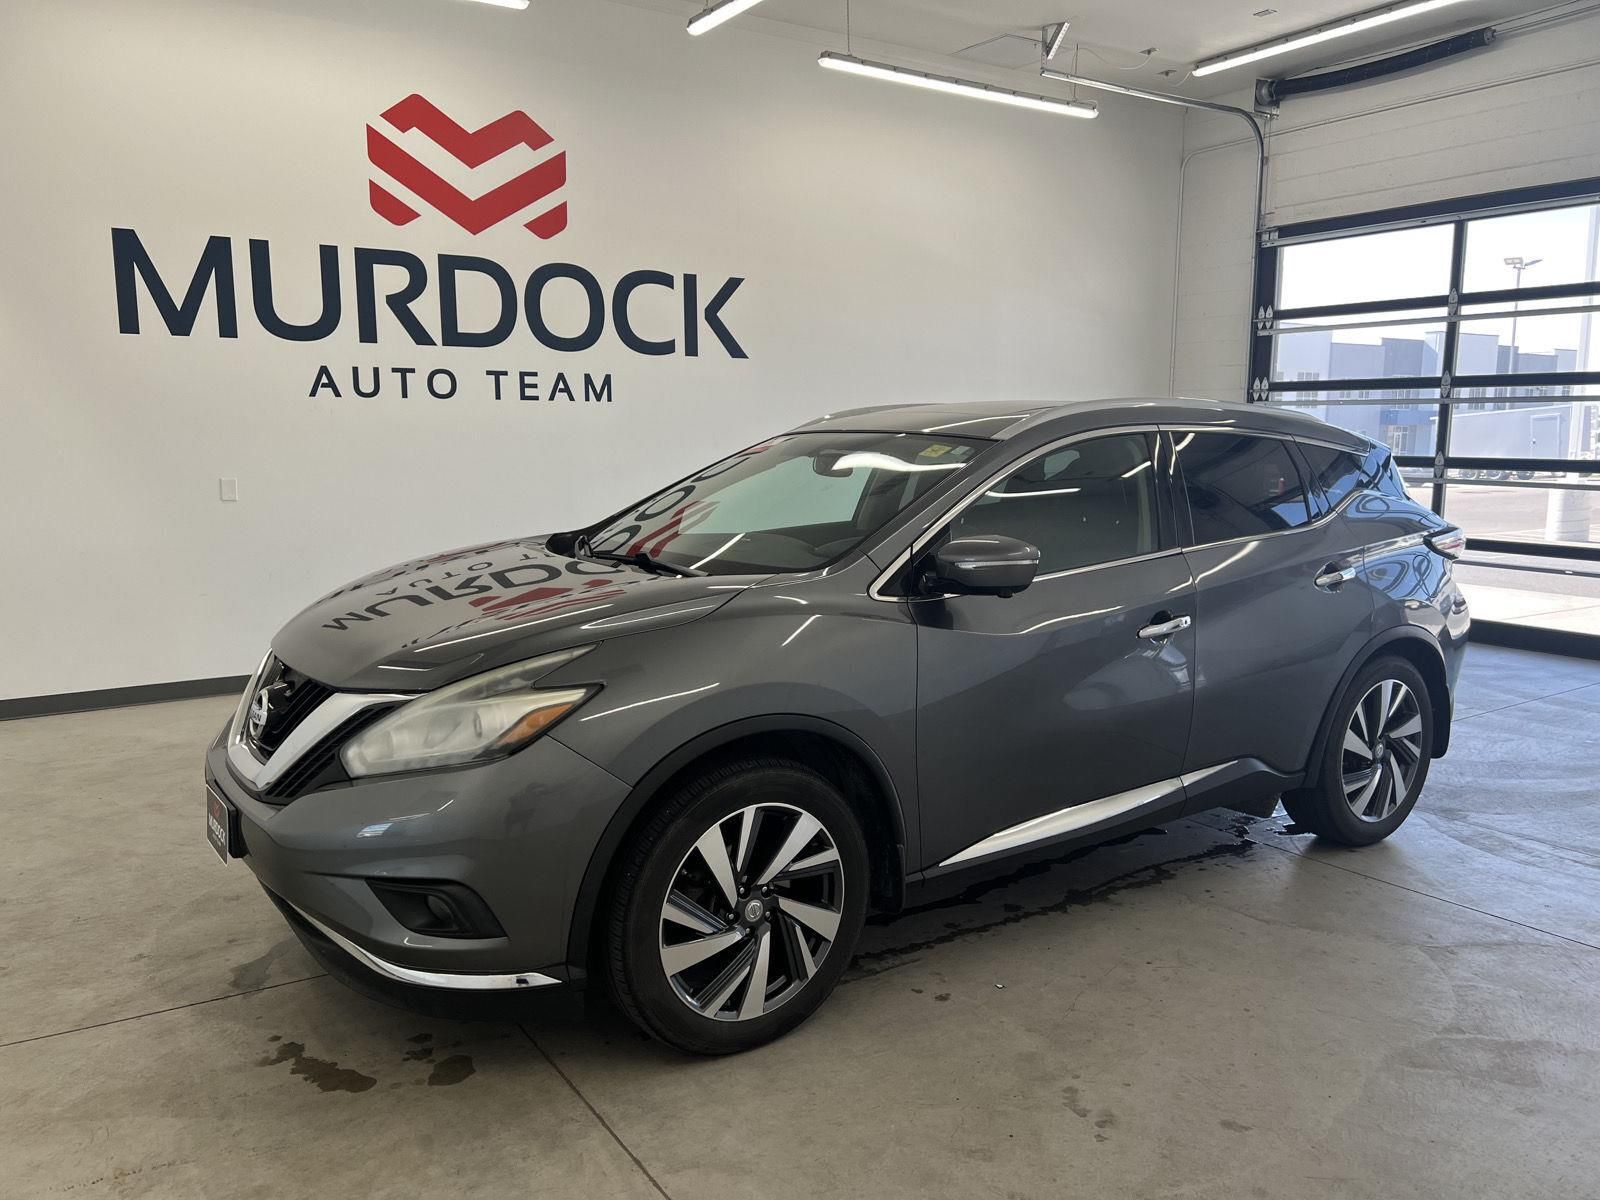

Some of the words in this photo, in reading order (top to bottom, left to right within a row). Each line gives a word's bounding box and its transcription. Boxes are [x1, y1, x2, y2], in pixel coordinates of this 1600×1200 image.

[111, 228, 749, 360] MURDOCK
[309, 365, 458, 400] AUTO
[486, 371, 613, 403] TEAM
